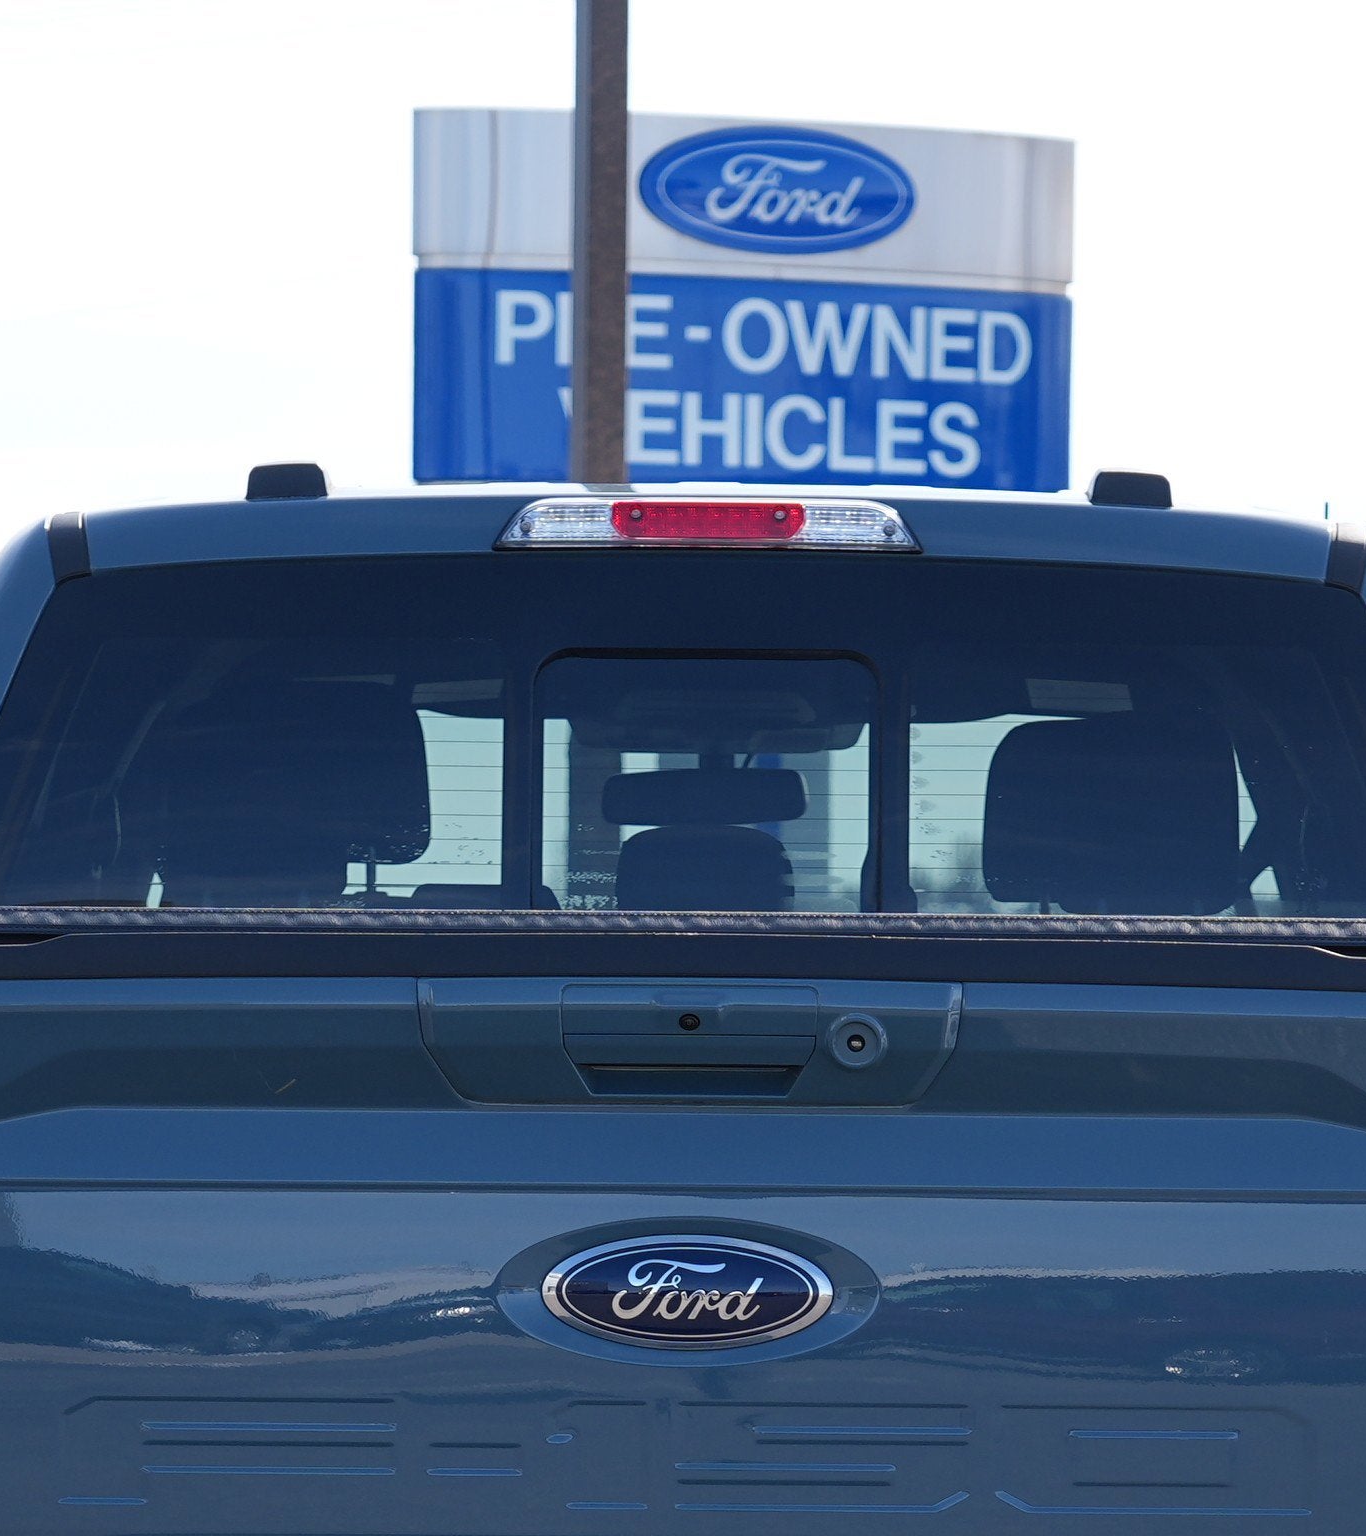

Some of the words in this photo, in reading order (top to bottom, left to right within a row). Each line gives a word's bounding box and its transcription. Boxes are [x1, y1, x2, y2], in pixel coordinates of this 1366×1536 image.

[703, 152, 865, 226] Ford
[558, 388, 981, 477] EHICLES
[611, 1258, 765, 1321] Ford
